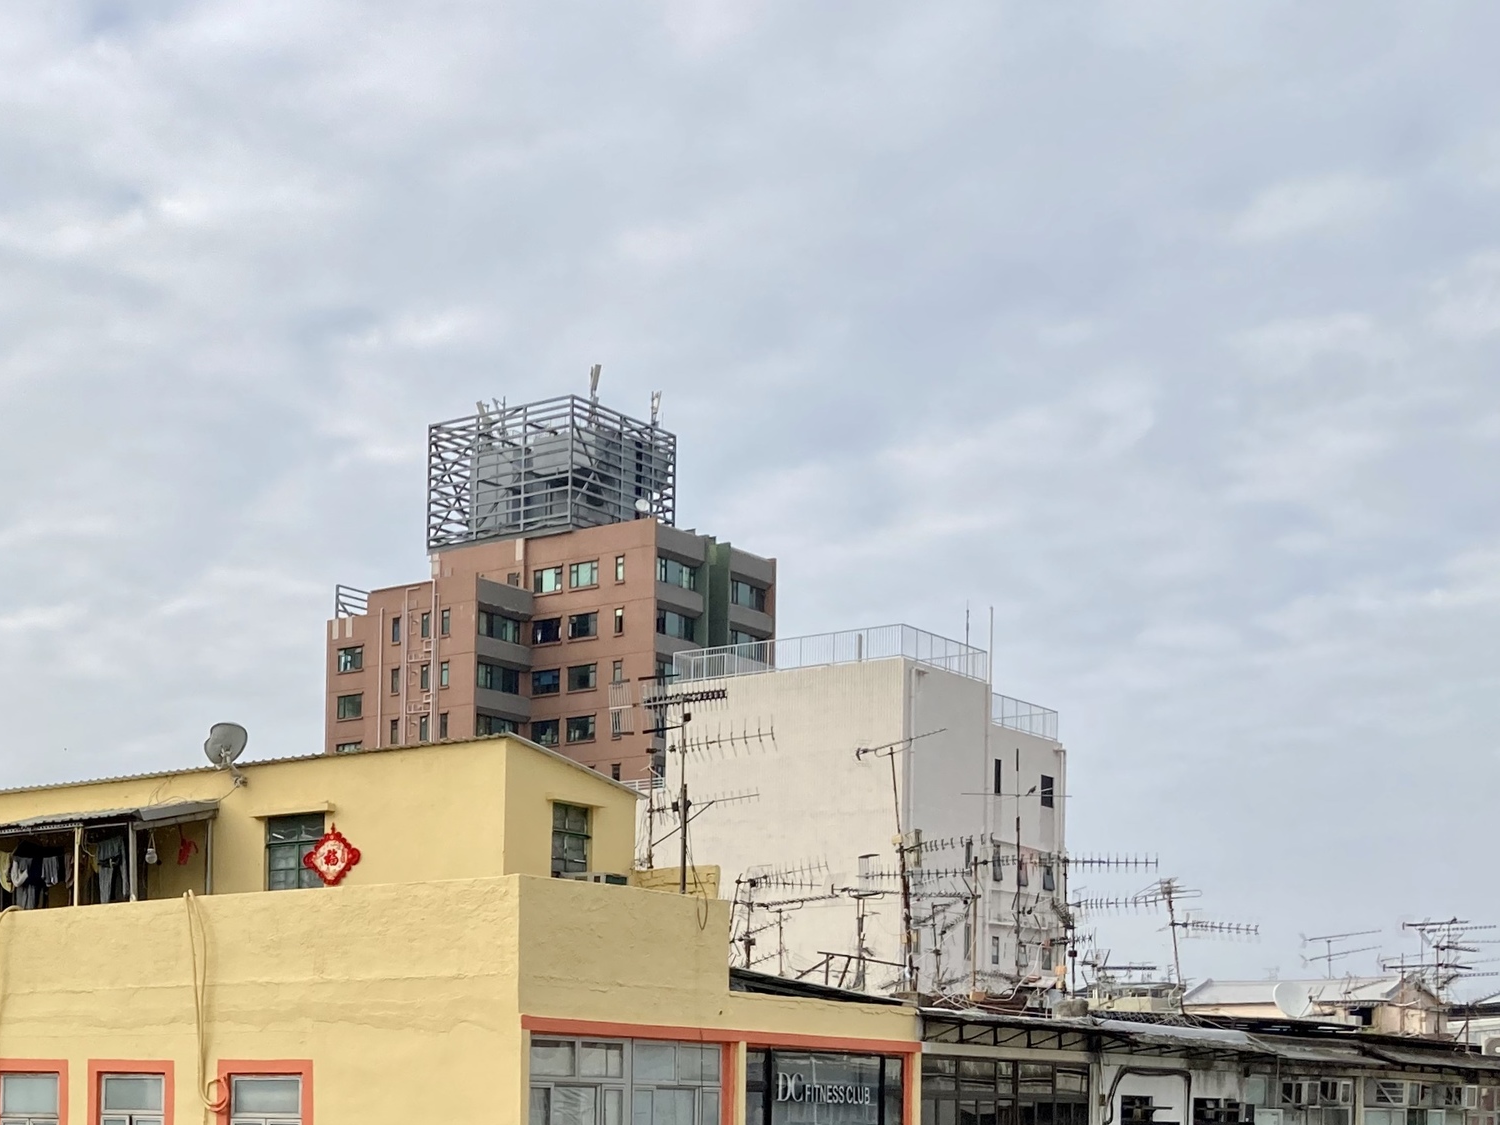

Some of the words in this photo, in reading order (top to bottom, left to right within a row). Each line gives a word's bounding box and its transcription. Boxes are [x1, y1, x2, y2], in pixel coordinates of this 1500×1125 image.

[777, 1072, 803, 1102] DC
[805, 1084, 845, 1104] FITNESS
[846, 1086, 870, 1104] CLUB
